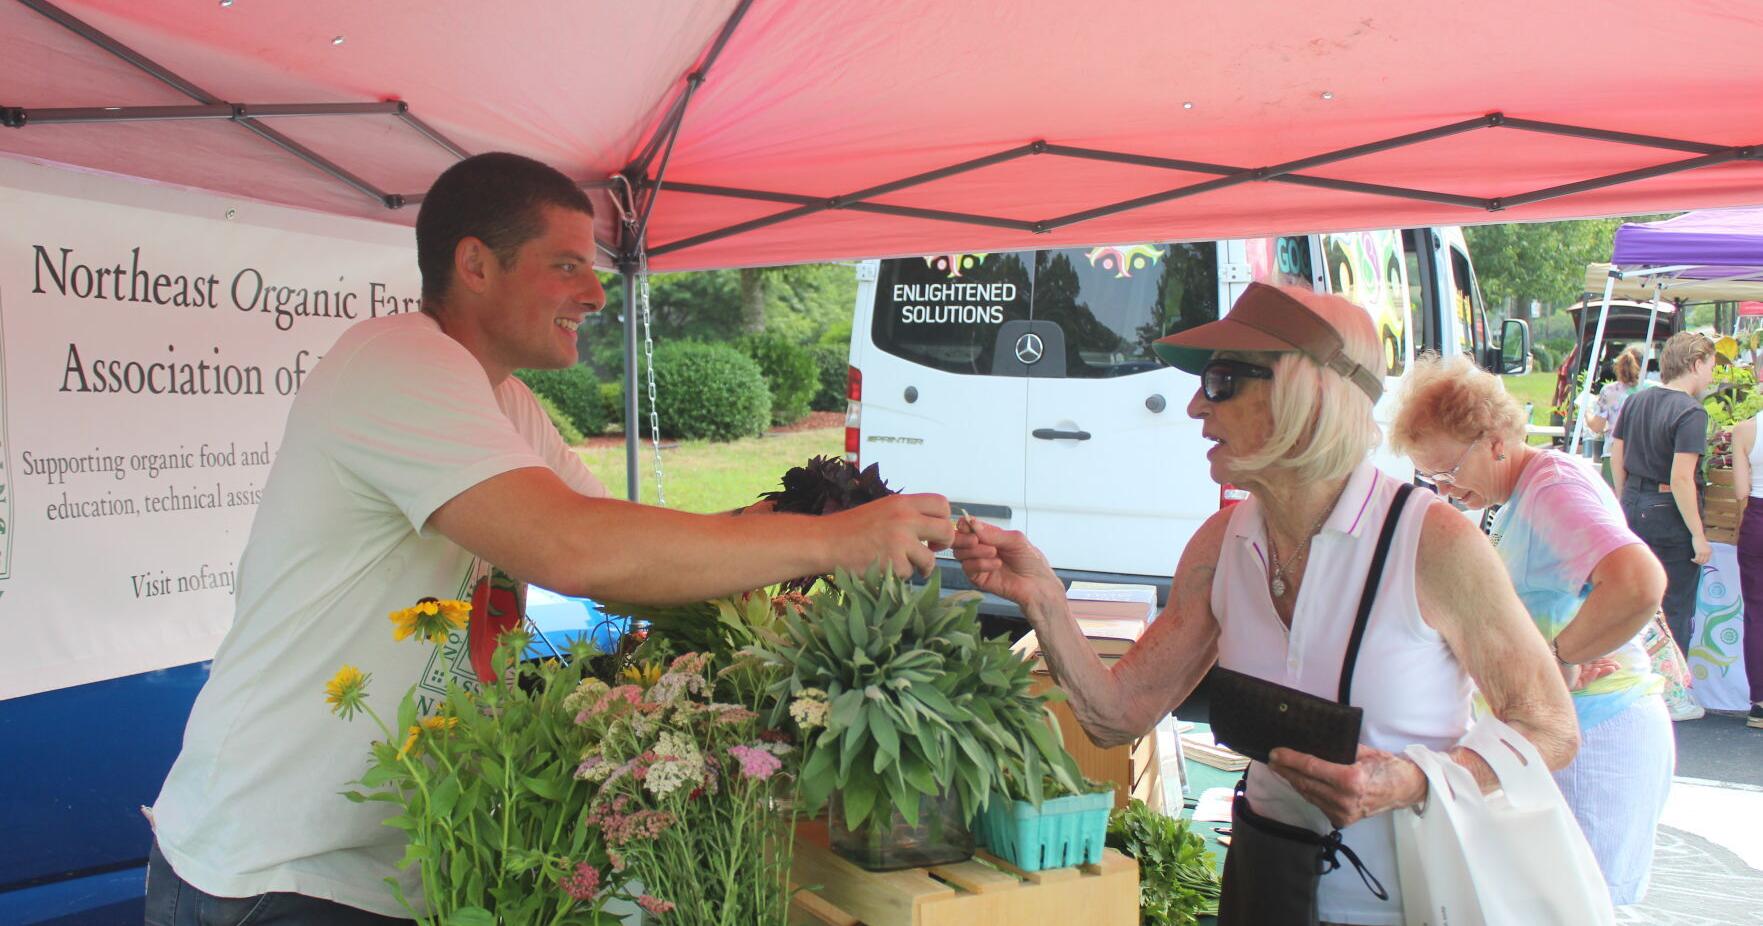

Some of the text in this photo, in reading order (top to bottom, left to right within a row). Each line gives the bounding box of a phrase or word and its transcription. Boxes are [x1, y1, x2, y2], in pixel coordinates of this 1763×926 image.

[32, 244, 219, 309] Northeast
[231, 268, 358, 331] Organic
[893, 283, 1016, 303] ENLIGHTENED
[901, 305, 1004, 324] SOLUTIONS
[59, 343, 309, 396] Association of
[22, 441, 270, 485] Supporting organic food and
[46, 482, 263, 521] education, technical assis
[131, 561, 236, 599] Visit nofanj
